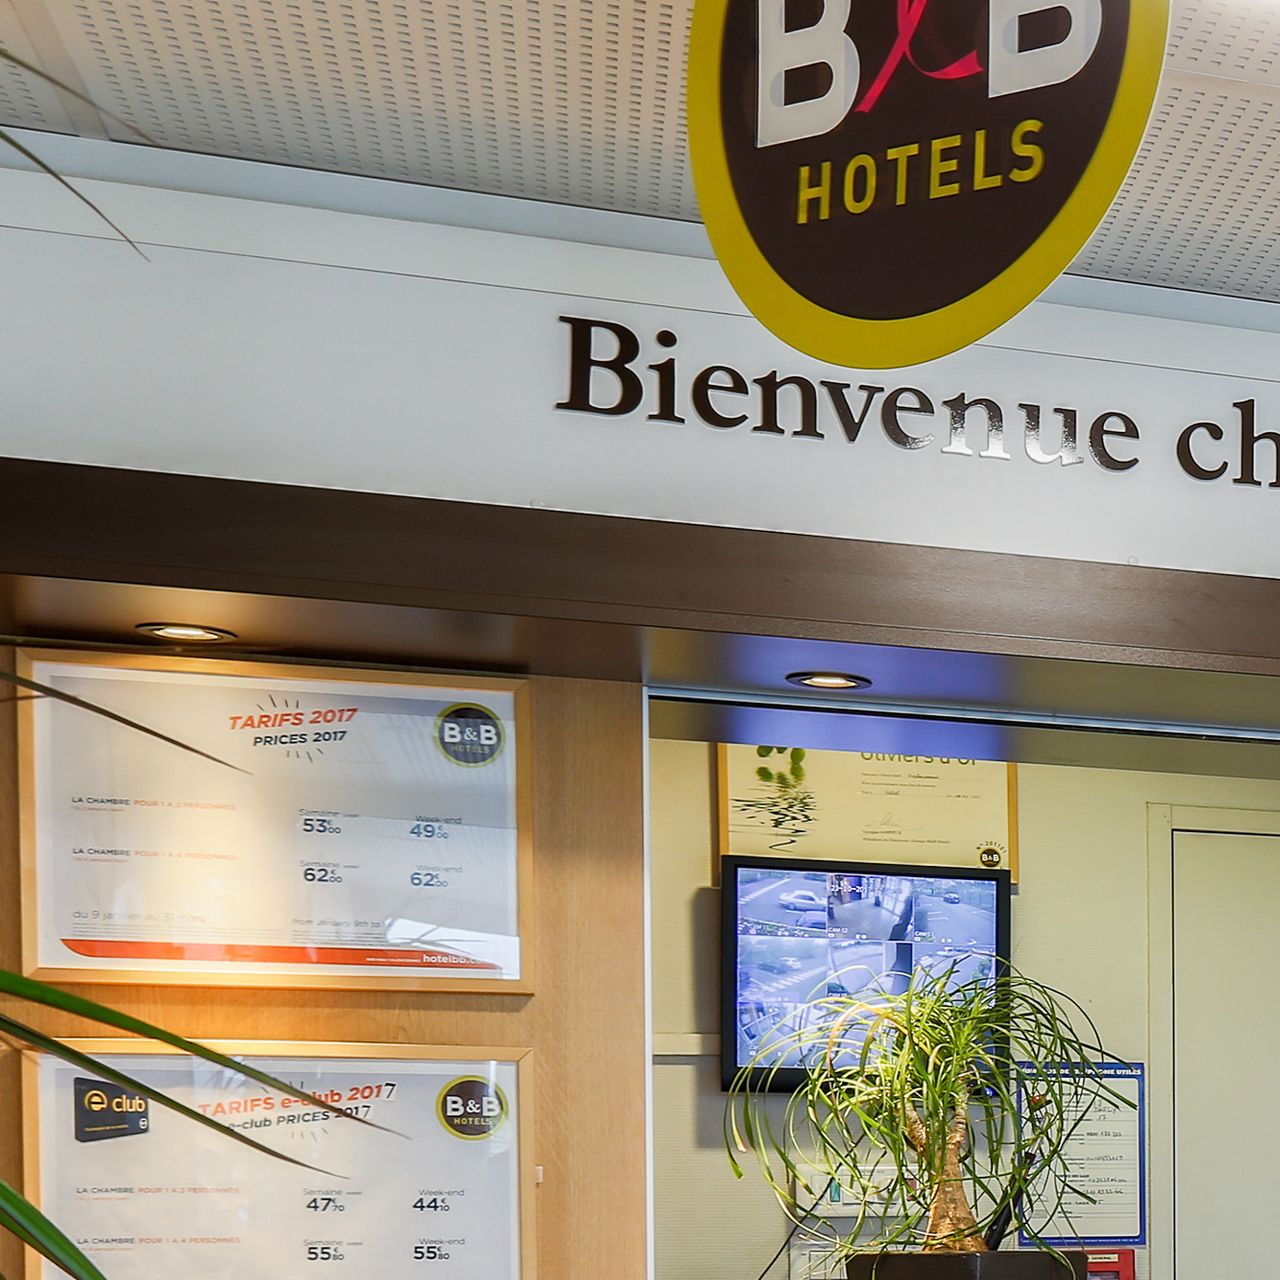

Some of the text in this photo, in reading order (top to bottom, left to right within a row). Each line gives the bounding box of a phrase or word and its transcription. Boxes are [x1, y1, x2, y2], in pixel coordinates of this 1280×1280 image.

[796, 119, 1045, 225] HOTELS
[555, 315, 1140, 471] Bienvenue
[228, 708, 359, 730] TARIFS 2017
[253, 731, 348, 747] PRICES 2017
[443, 722, 498, 745] B&B
[451, 744, 490, 754] HOTELS
[112, 1094, 146, 1113] club
[199, 1096, 276, 1117] TARIFS
[347, 1082, 397, 1101] 2017
[446, 1096, 500, 1118] B&B
[276, 1110, 330, 1126] PRICES
[454, 1117, 493, 1126] HOTELS
[418, 1189, 465, 1197] Week-end
